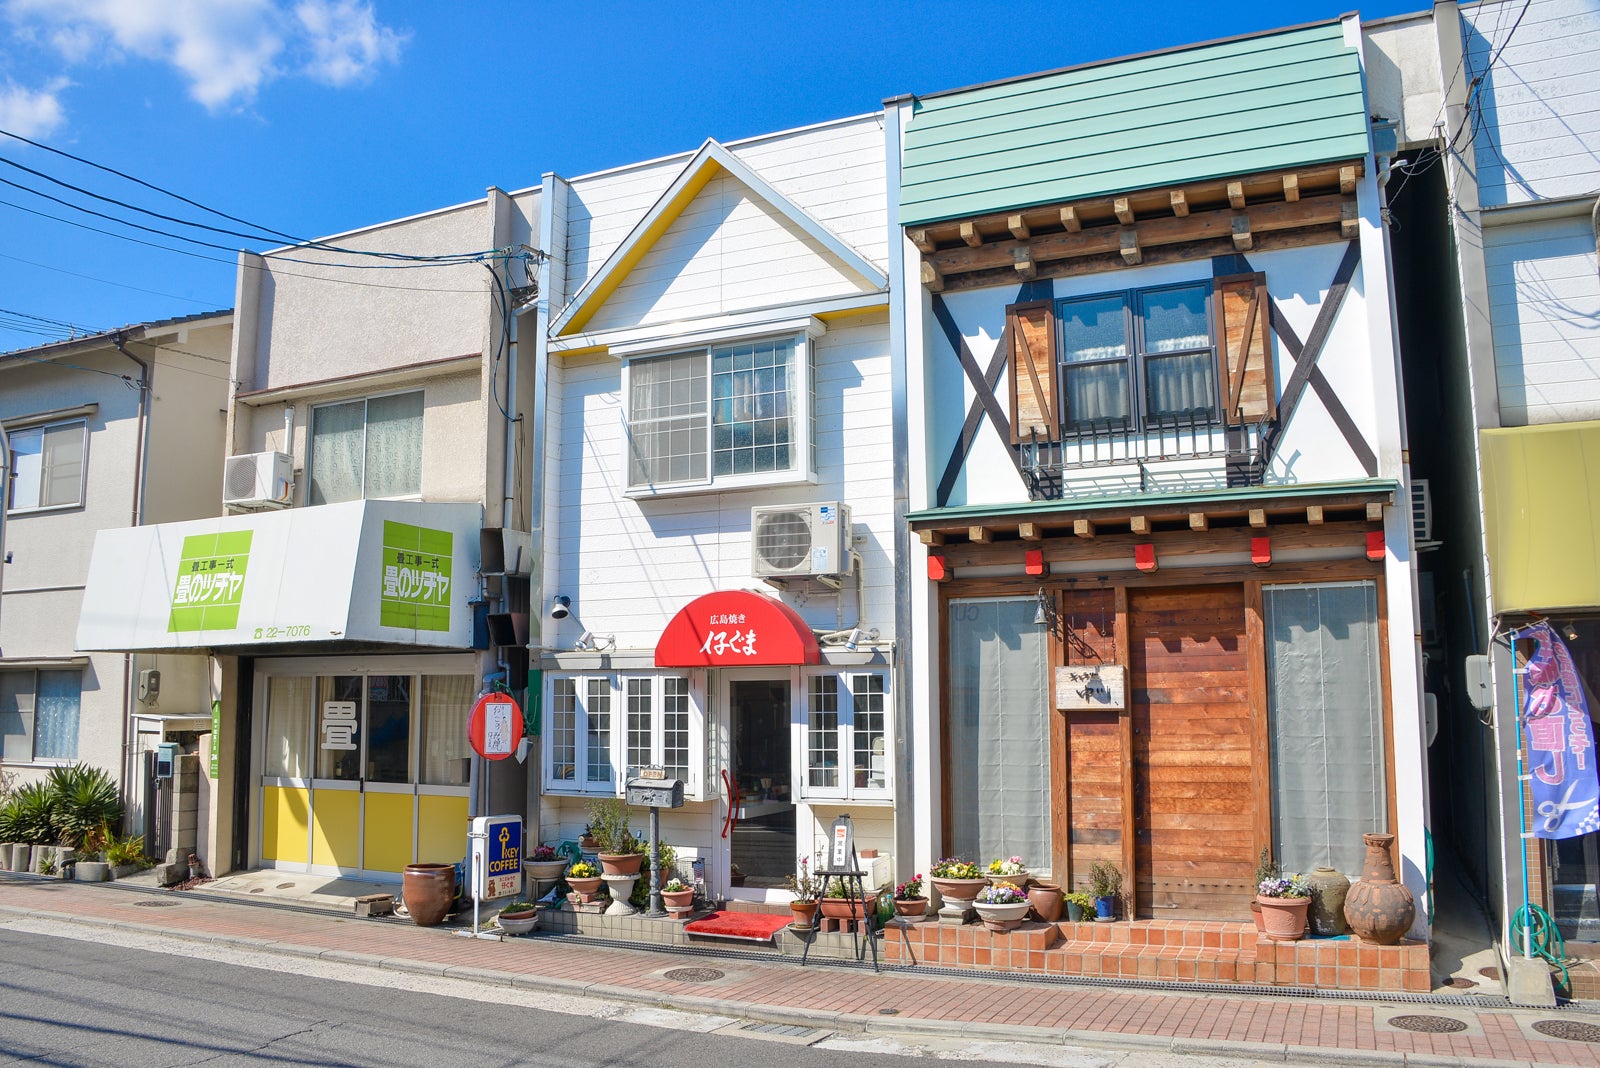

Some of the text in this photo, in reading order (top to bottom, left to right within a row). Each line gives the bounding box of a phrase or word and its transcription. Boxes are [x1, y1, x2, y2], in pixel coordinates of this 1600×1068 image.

[191, 559, 235, 571] 畳工事一式
[397, 552, 439, 568] 畳工事一式
[174, 572, 243, 603] 畳のツチヤ
[383, 565, 449, 601] 畳のツチヤ
[709, 614, 746, 625] 広島焼き
[699, 629, 757, 656] 仔ぐま
[321, 701, 358, 750] 畳
[505, 847, 519, 859] KEY
[489, 859, 519, 873] COFFEE
